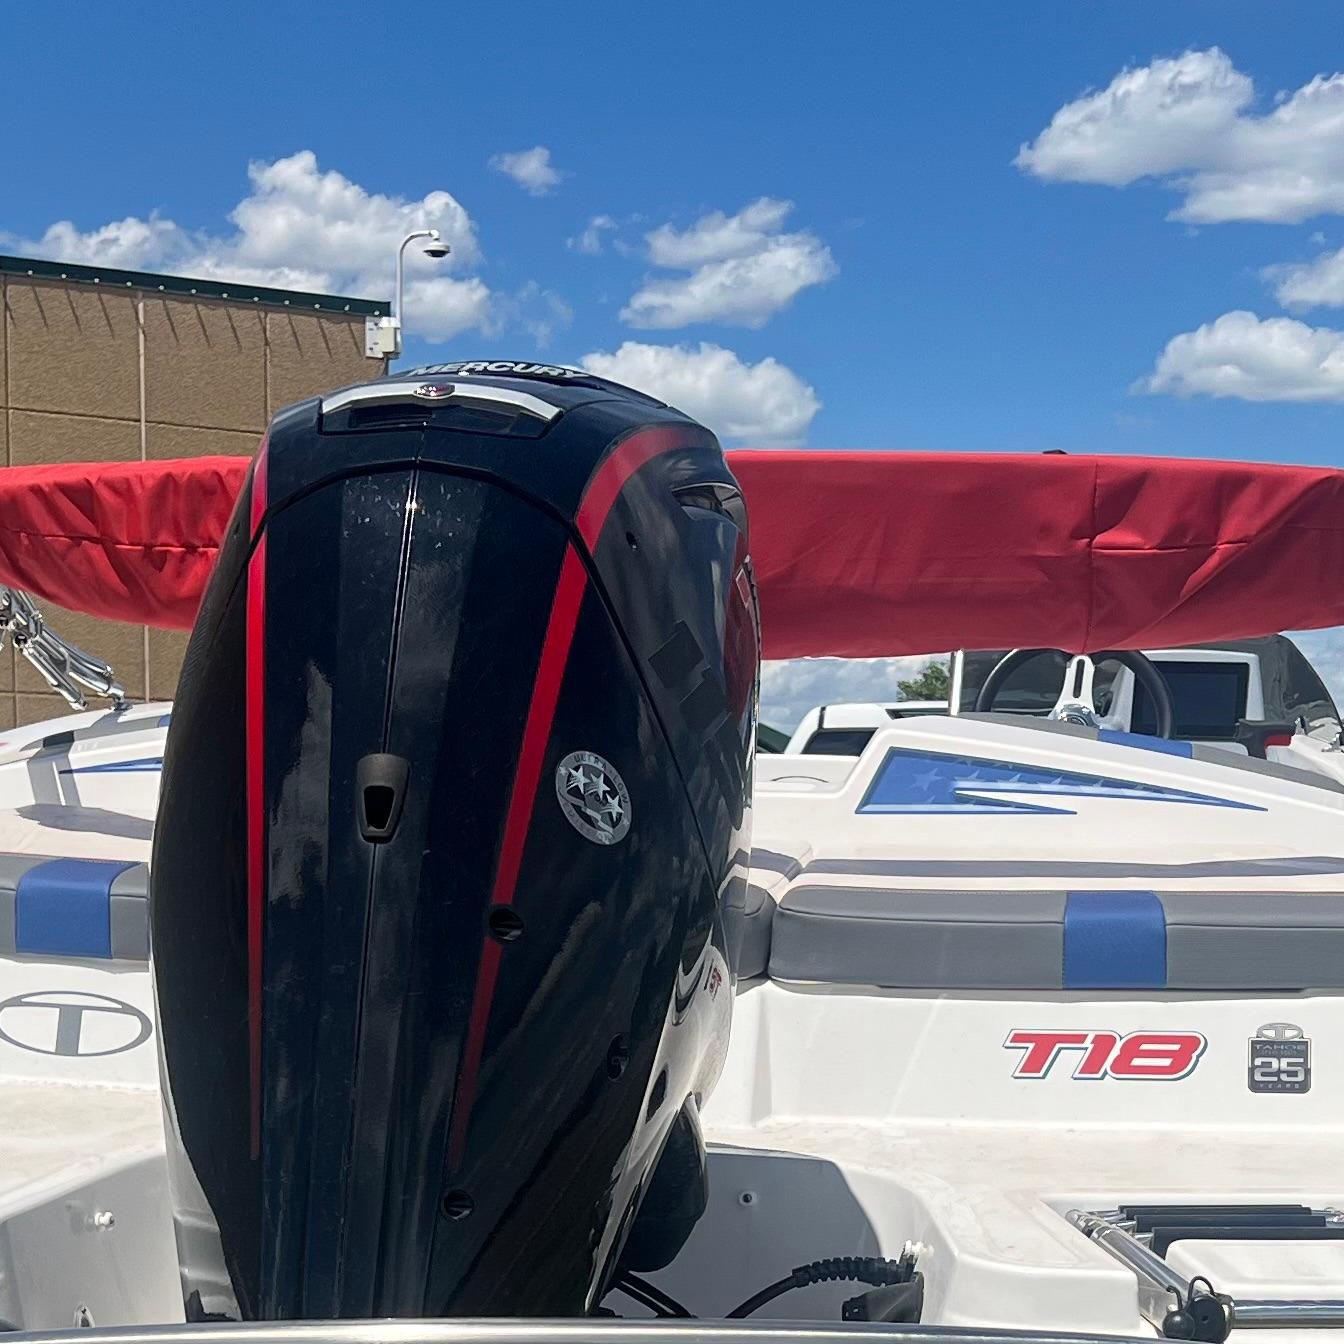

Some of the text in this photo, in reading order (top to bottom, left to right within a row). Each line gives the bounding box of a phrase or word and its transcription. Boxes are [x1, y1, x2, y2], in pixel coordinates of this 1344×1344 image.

[407, 361, 591, 378] MERCURY
[1003, 1029, 1209, 1080] T18
[1254, 1043, 1306, 1051] TAHOE
[1254, 1056, 1305, 1082] 25
